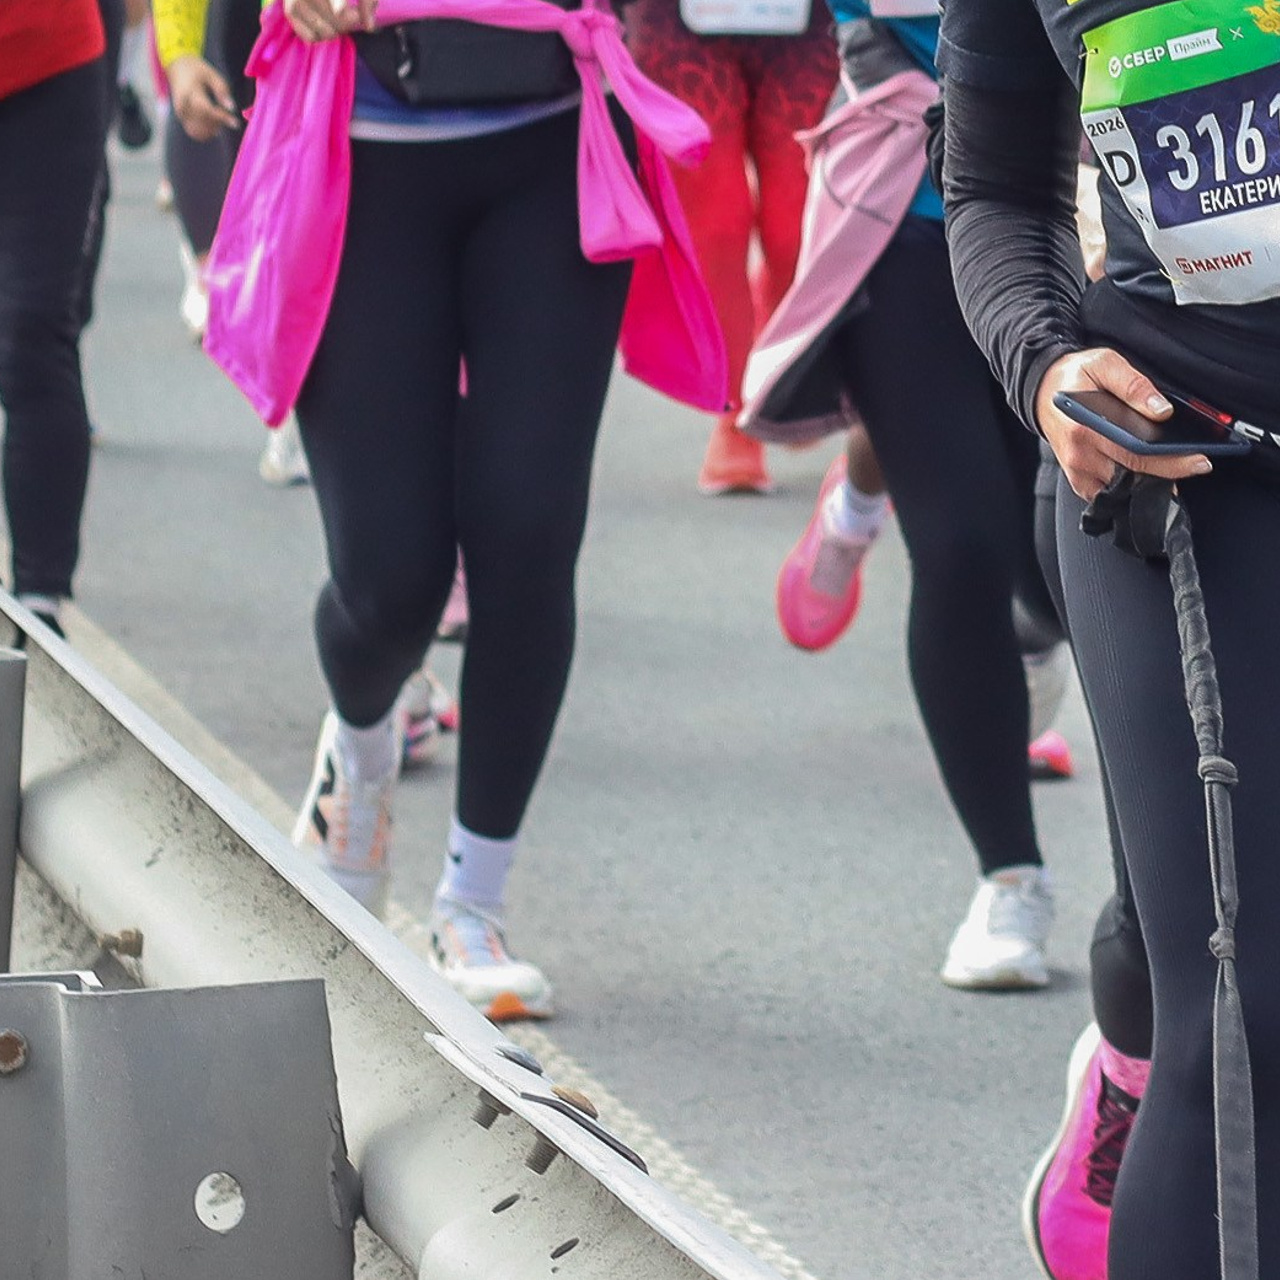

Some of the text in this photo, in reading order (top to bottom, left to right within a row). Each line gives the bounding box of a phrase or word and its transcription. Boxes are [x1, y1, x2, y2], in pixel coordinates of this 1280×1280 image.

[1123, 46, 1166, 69] СБЕР
[1087, 116, 1125, 137] 2026
[1104, 150, 1137, 187] D
[1190, 250, 1253, 273] МАГНИТ
